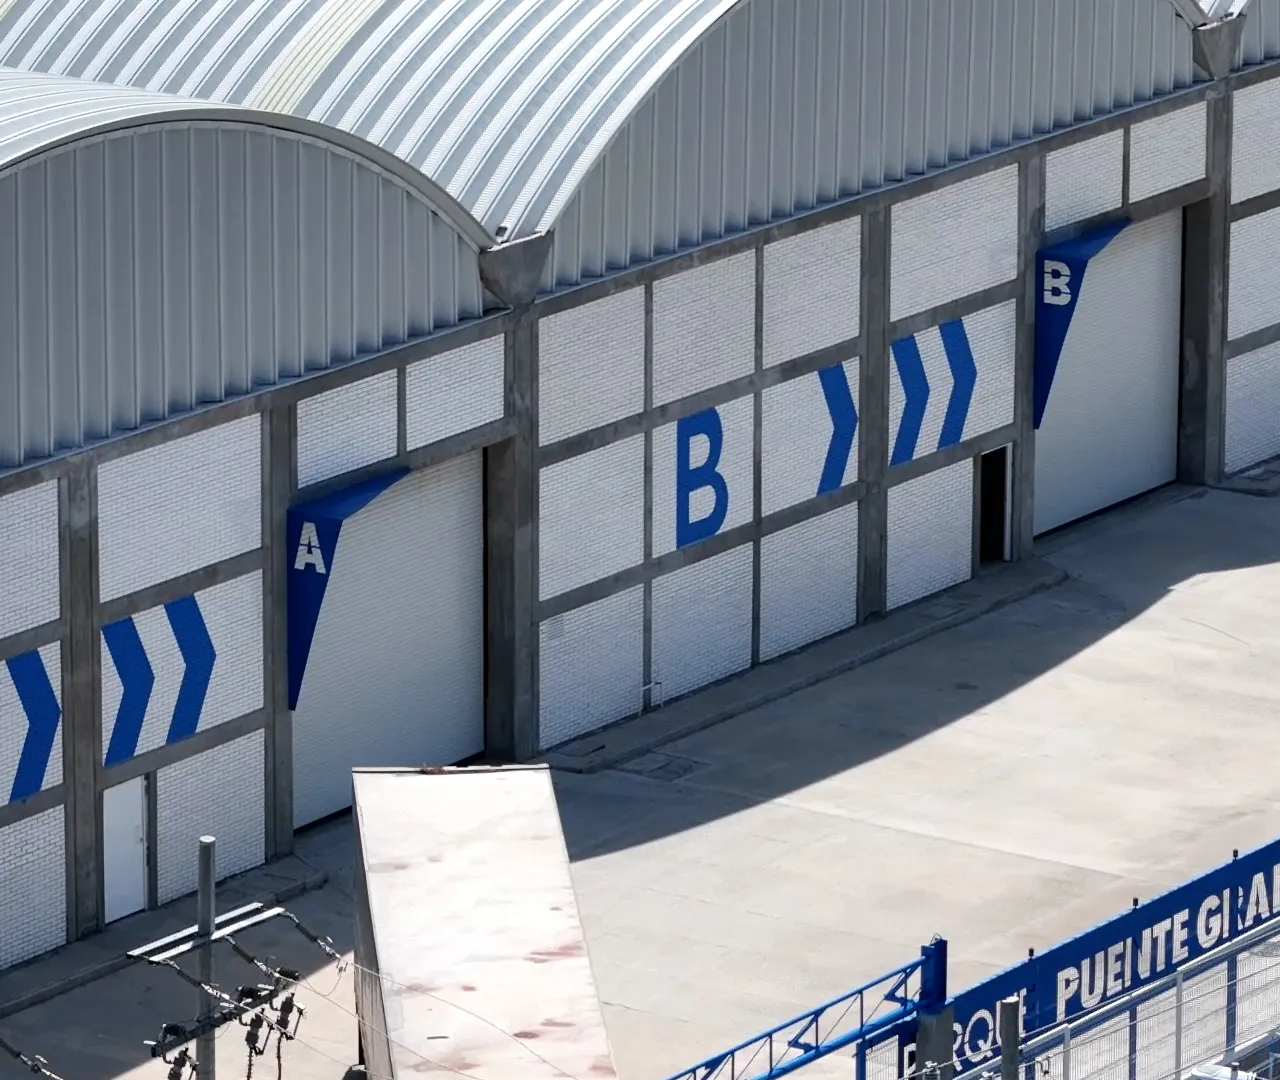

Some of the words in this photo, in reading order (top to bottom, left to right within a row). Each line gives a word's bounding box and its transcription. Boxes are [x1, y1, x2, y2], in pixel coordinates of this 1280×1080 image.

[1043, 259, 1072, 307] B
[675, 405, 730, 549] B
[294, 521, 327, 574] A
[1056, 908, 1189, 1022] PUENTE
